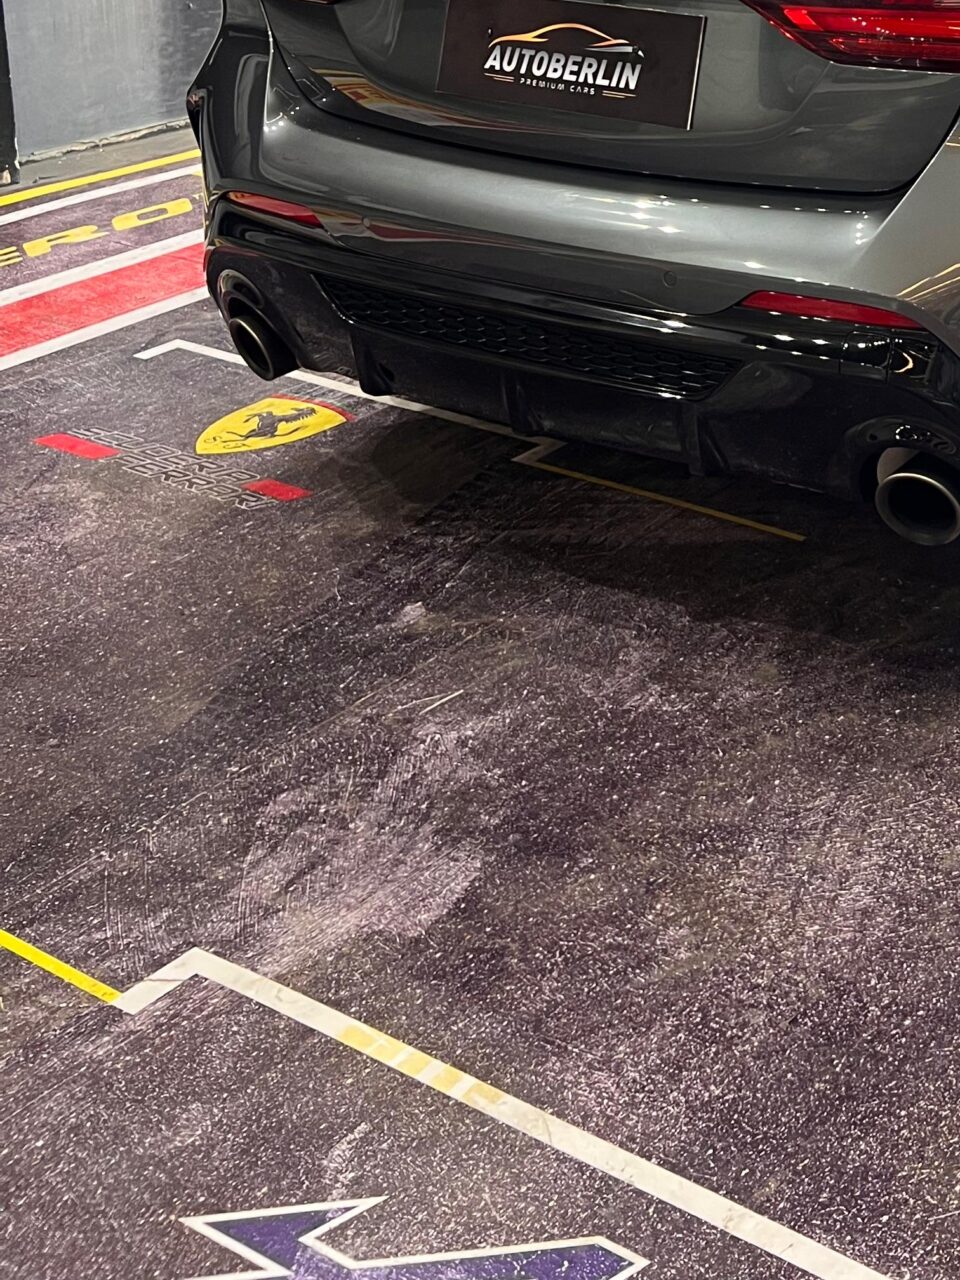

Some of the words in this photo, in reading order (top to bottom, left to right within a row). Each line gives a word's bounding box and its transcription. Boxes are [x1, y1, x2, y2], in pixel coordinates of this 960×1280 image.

[484, 45, 642, 90] AUTOBERLIN
[519, 77, 565, 91] PREMIUM
[569, 84, 595, 95] CARS
